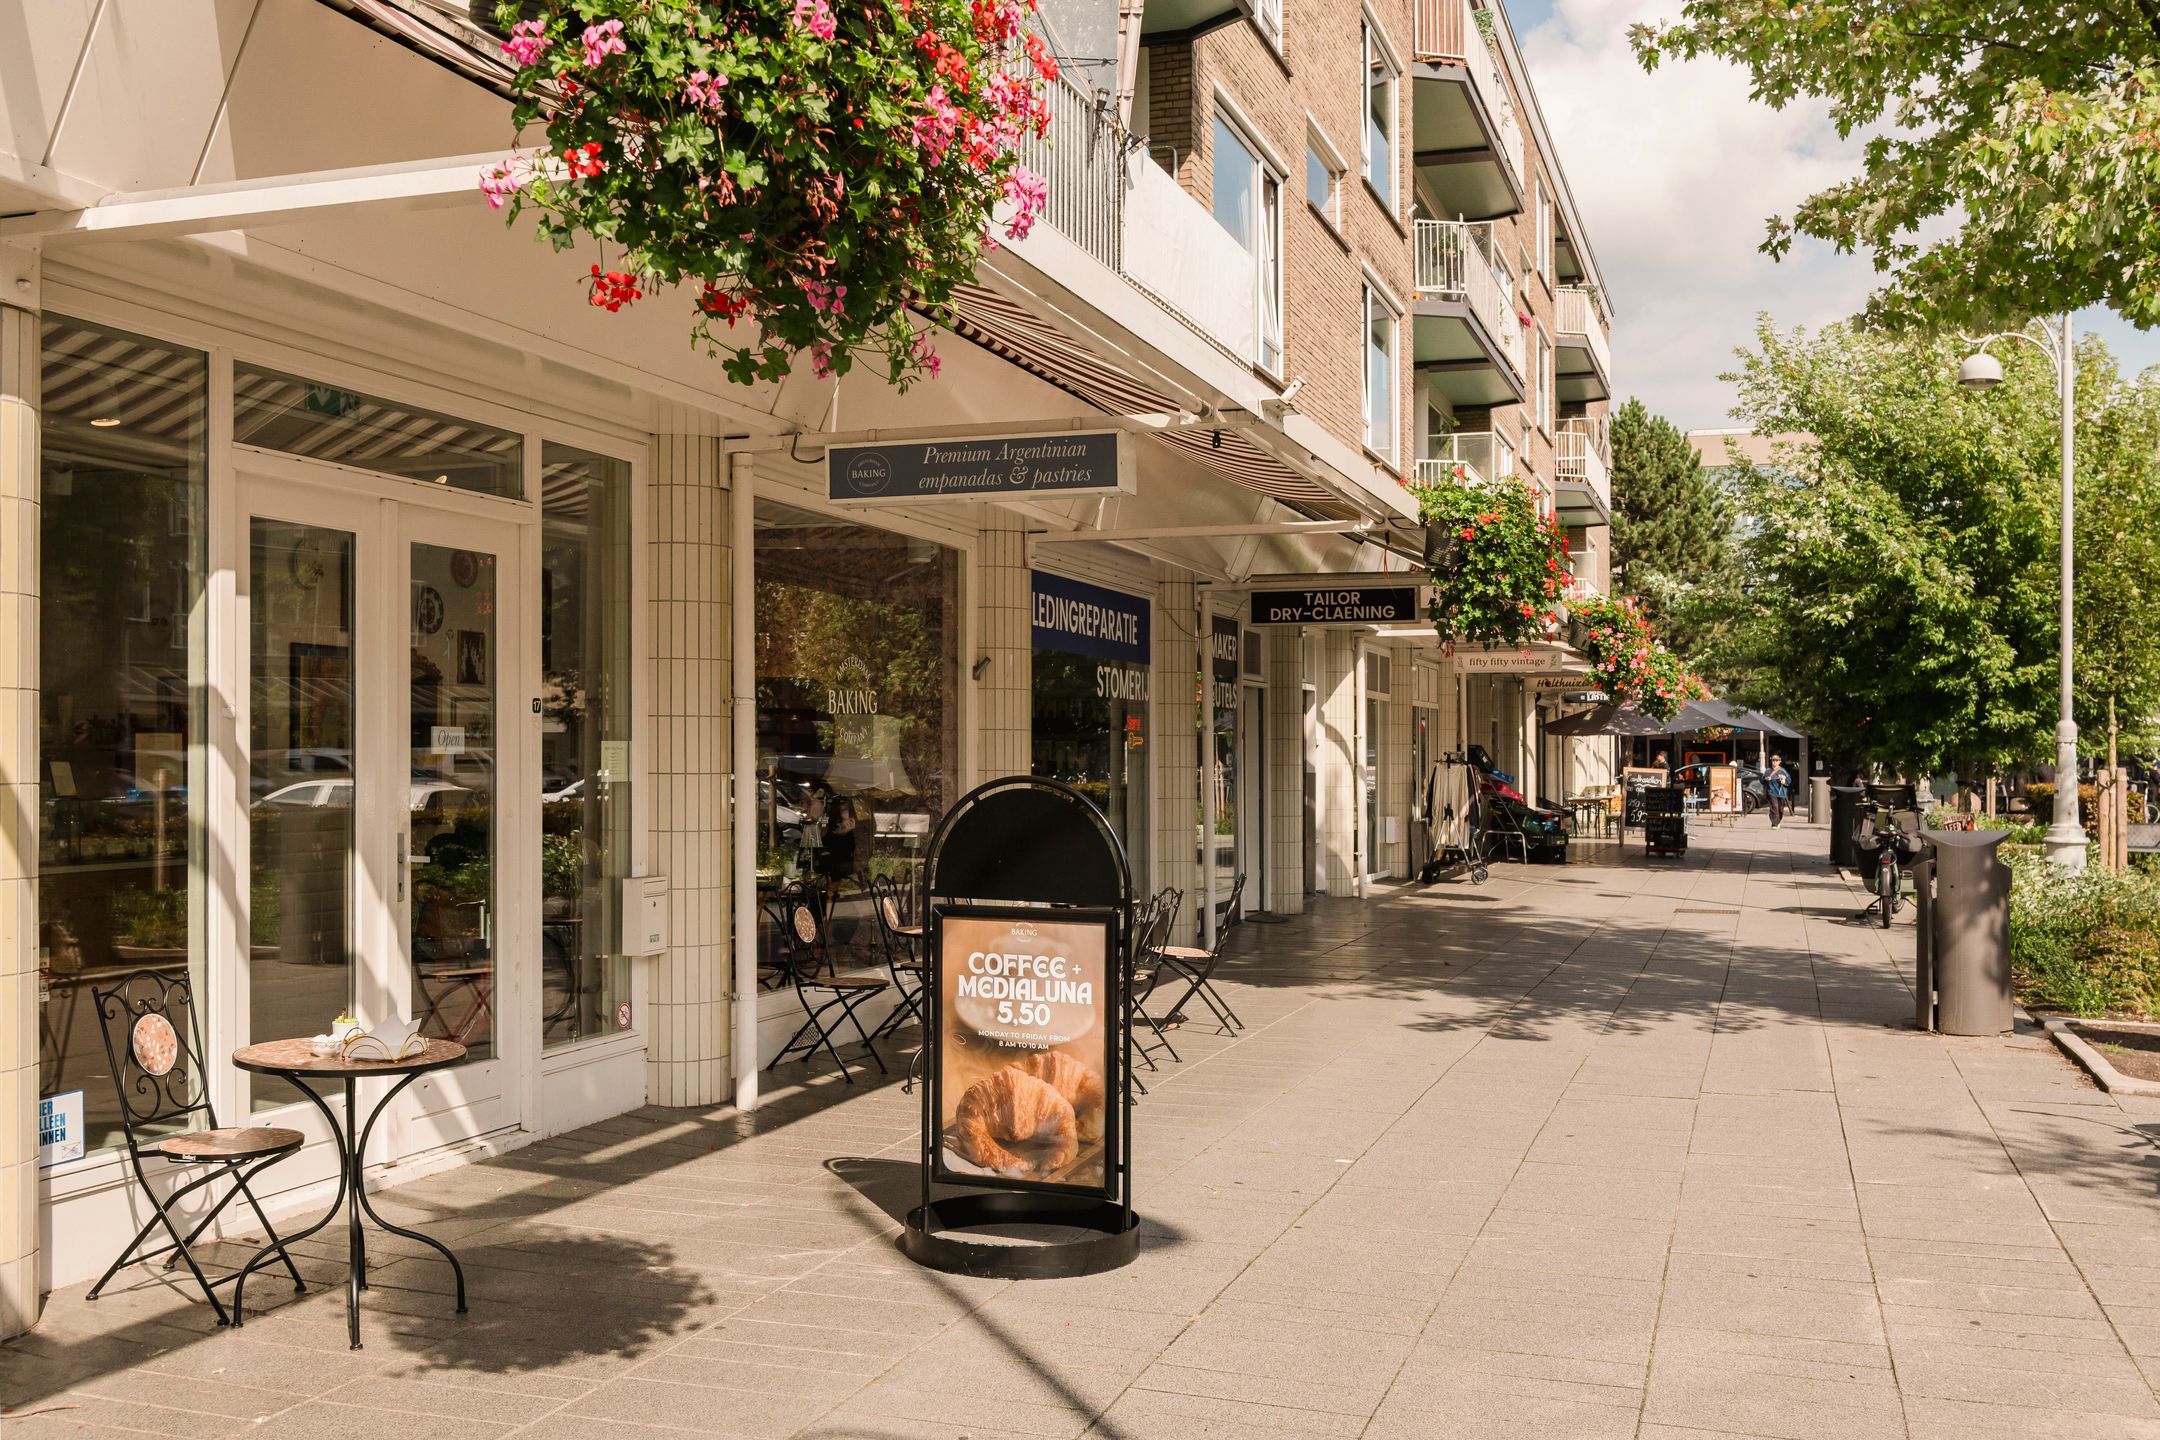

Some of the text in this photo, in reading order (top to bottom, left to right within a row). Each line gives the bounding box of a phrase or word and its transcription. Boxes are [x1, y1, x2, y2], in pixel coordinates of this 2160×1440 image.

[923, 439, 1087, 466] Premium Argentinian
[852, 469, 886, 479] BAKING
[919, 464, 1092, 497] empanadas & pastries
[1304, 591, 1361, 606] TAILOR
[1270, 605, 1396, 621] DRY-CLAENING
[1469, 656, 1546, 668] fifty fifty vintage
[533, 700, 540, 712] 17
[828, 690, 878, 714] BAKING
[437, 729, 460, 751] Open
[1011, 928, 1038, 937] BAKING
[968, 952, 1082, 979] COFFEE +
[958, 975, 1093, 1005] MEDIALUNA
[996, 1001, 1051, 1027] 5,50
[978, 1030, 1009, 1038] MONDAY
[1049, 1034, 1071, 1042] FROM
